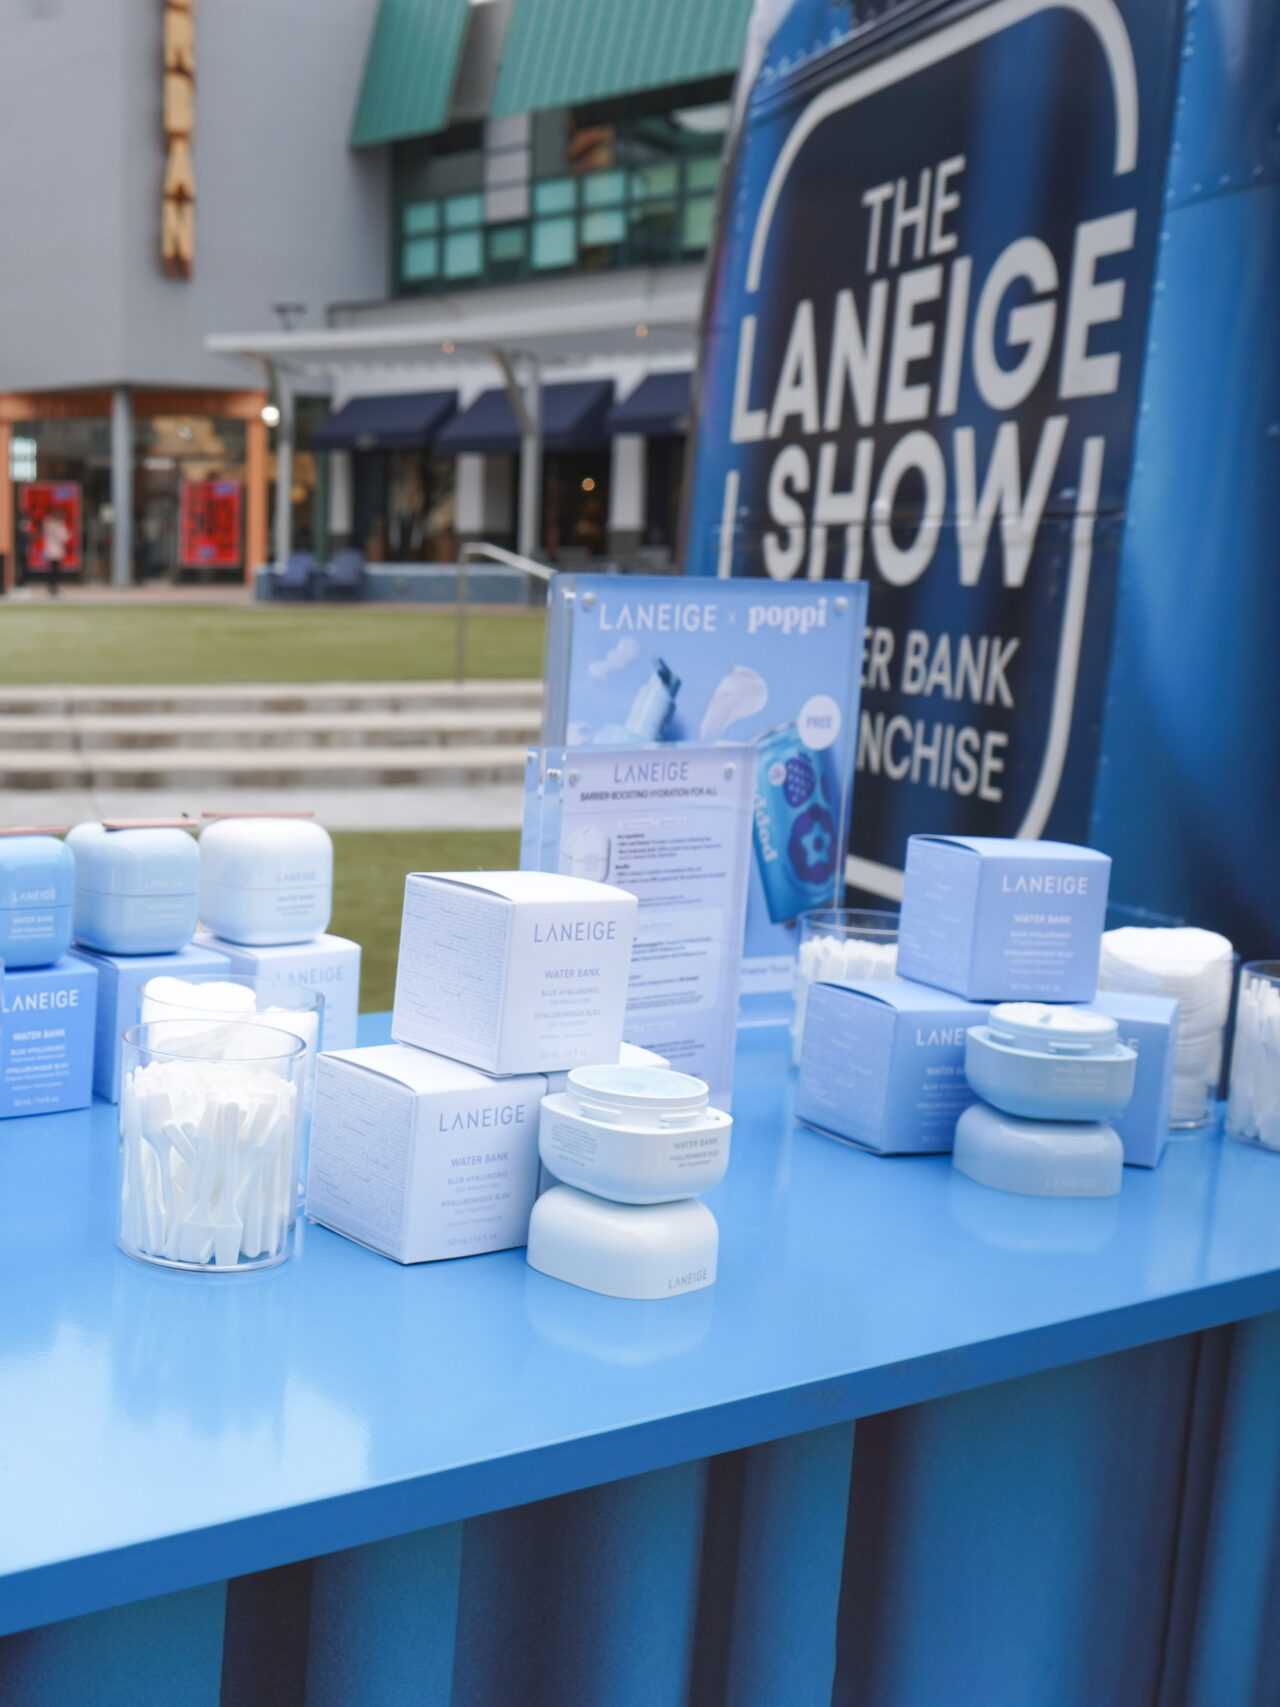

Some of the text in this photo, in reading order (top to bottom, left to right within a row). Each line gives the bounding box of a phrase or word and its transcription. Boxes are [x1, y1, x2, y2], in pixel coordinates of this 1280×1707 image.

[861, 155, 966, 275] THE
[730, 208, 1137, 444] LANEIGE
[762, 415, 1068, 588] SHOW
[598, 603, 718, 632] LANEIGE
[747, 597, 828, 635] poppi
[901, 628, 1019, 708] BANK
[806, 715, 833, 731] FREE
[857, 709, 1008, 802] NCHISE
[614, 761, 690, 783] LANEIGE
[12, 889, 56, 902] LANEIGE
[1002, 875, 1088, 895] LANEIGE
[533, 921, 617, 943] LANEIGE
[544, 967, 600, 979] WATER BANK
[1, 989, 79, 1014] LANEIGE
[916, 1027, 965, 1047] LANE
[439, 1104, 525, 1132] LANEIGE
[673, 1137, 718, 1151] WATER BANK
[451, 1151, 509, 1168] WATER BANK
[668, 1268, 708, 1290] LANEIGE
